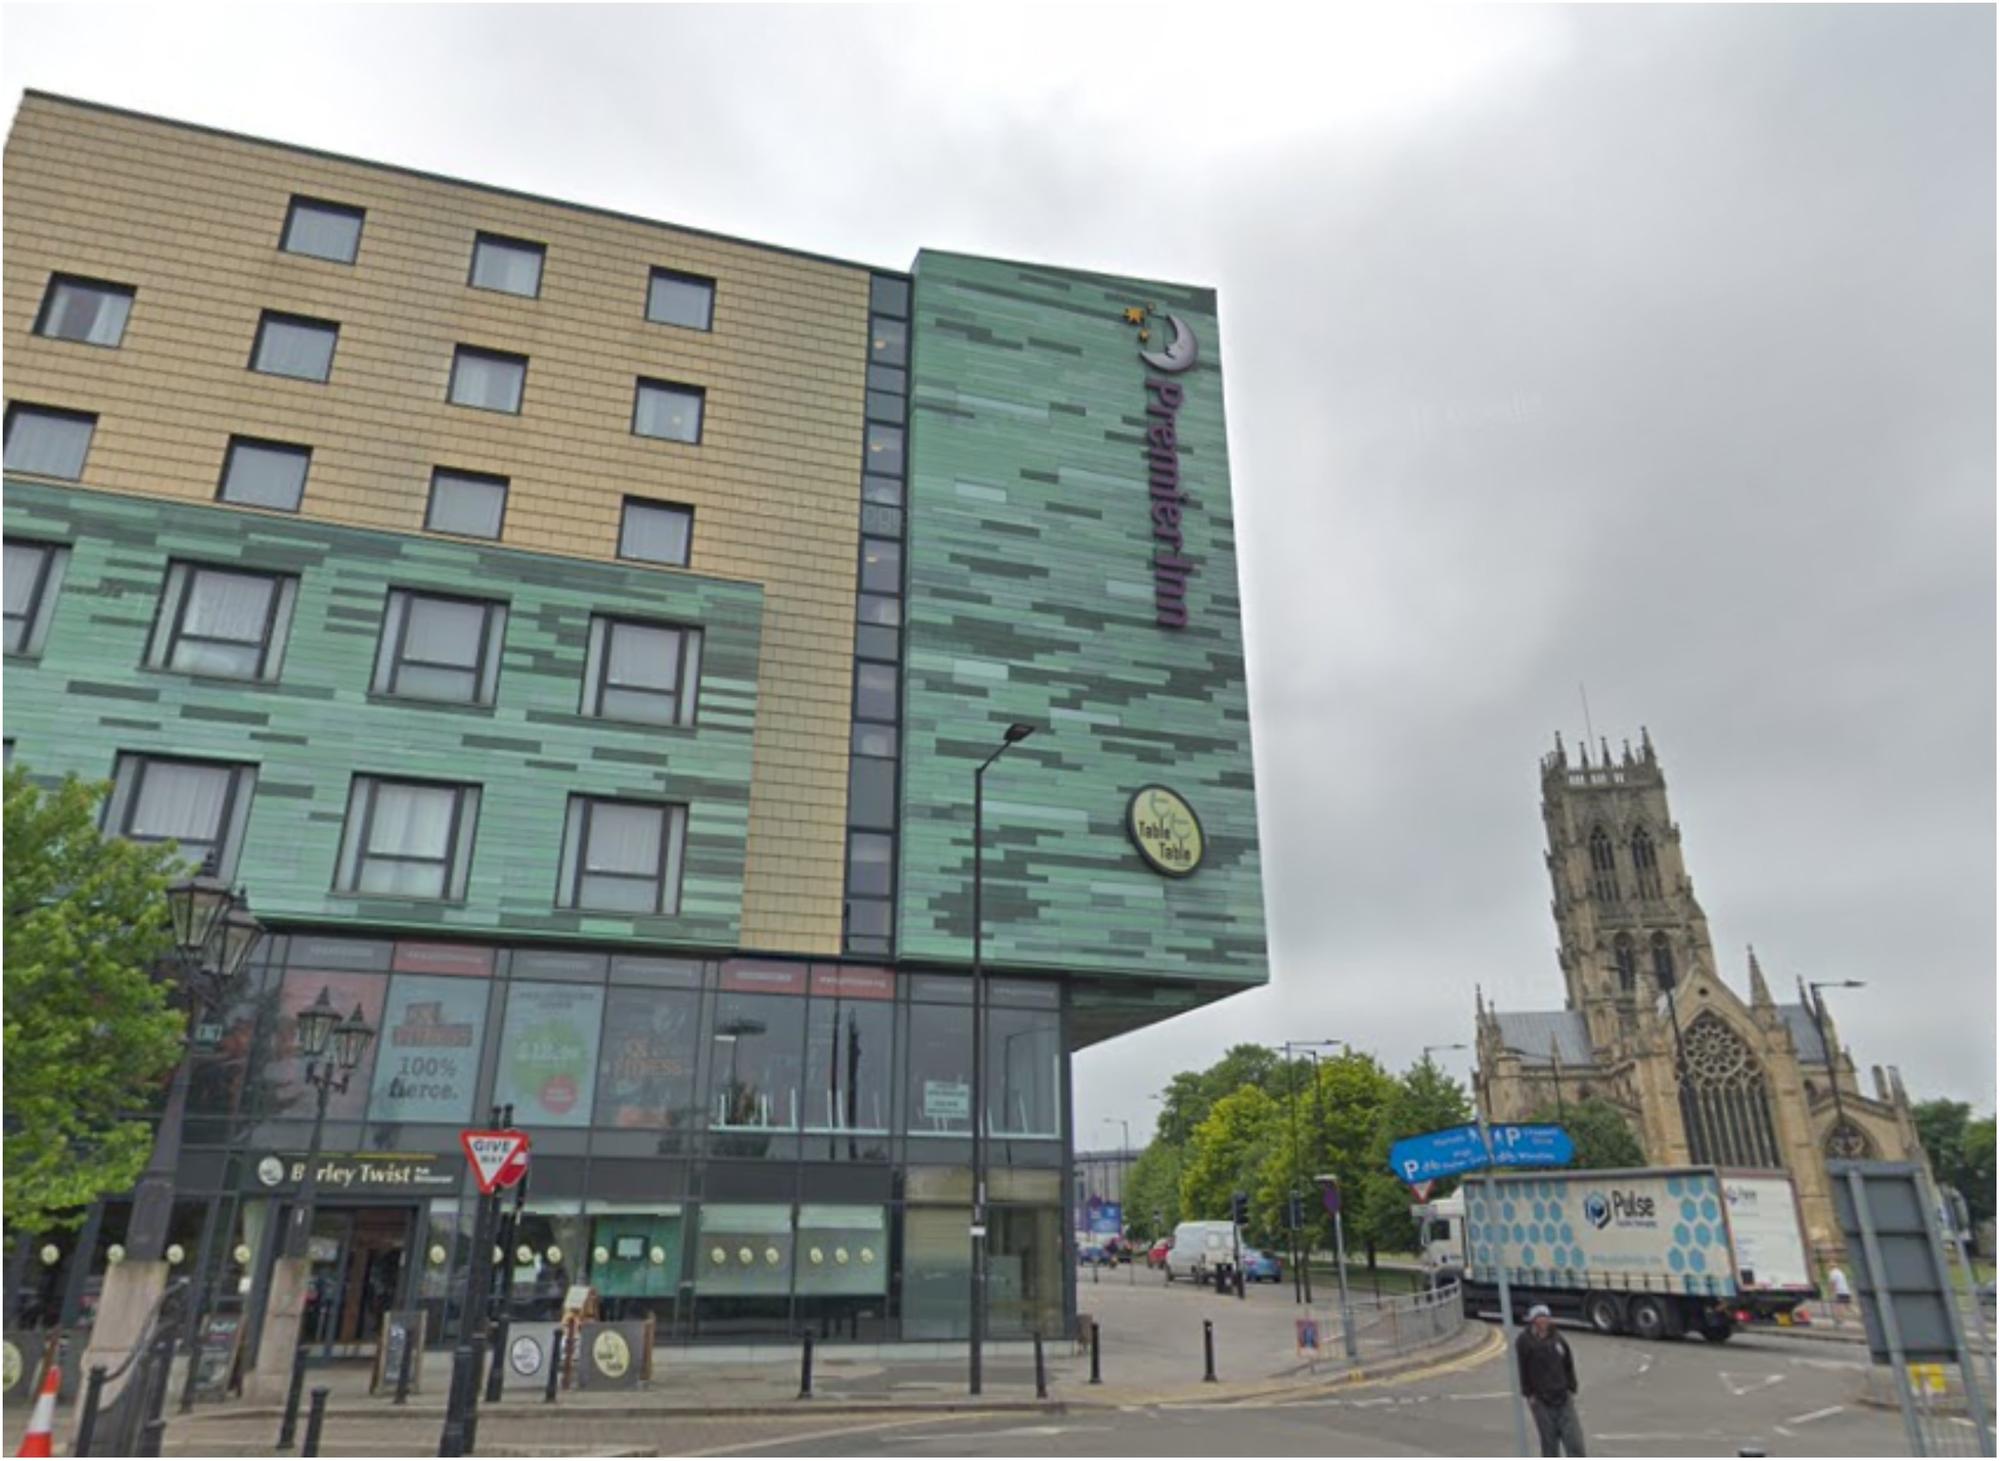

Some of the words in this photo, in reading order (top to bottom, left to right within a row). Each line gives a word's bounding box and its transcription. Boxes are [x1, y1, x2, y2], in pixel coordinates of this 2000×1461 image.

[1145, 379, 1188, 553] Premier
[1153, 555, 1191, 628] Inn
[1139, 820, 1170, 840] Table
[1158, 842, 1191, 861] Table
[398, 1056, 457, 1079] 100%
[474, 1139, 513, 1152] GIVE
[290, 1162, 356, 1188] Brley
[360, 1163, 410, 1184] Twist
[1404, 1159, 1419, 1180] P
[1612, 1190, 1655, 1217] Pulse
